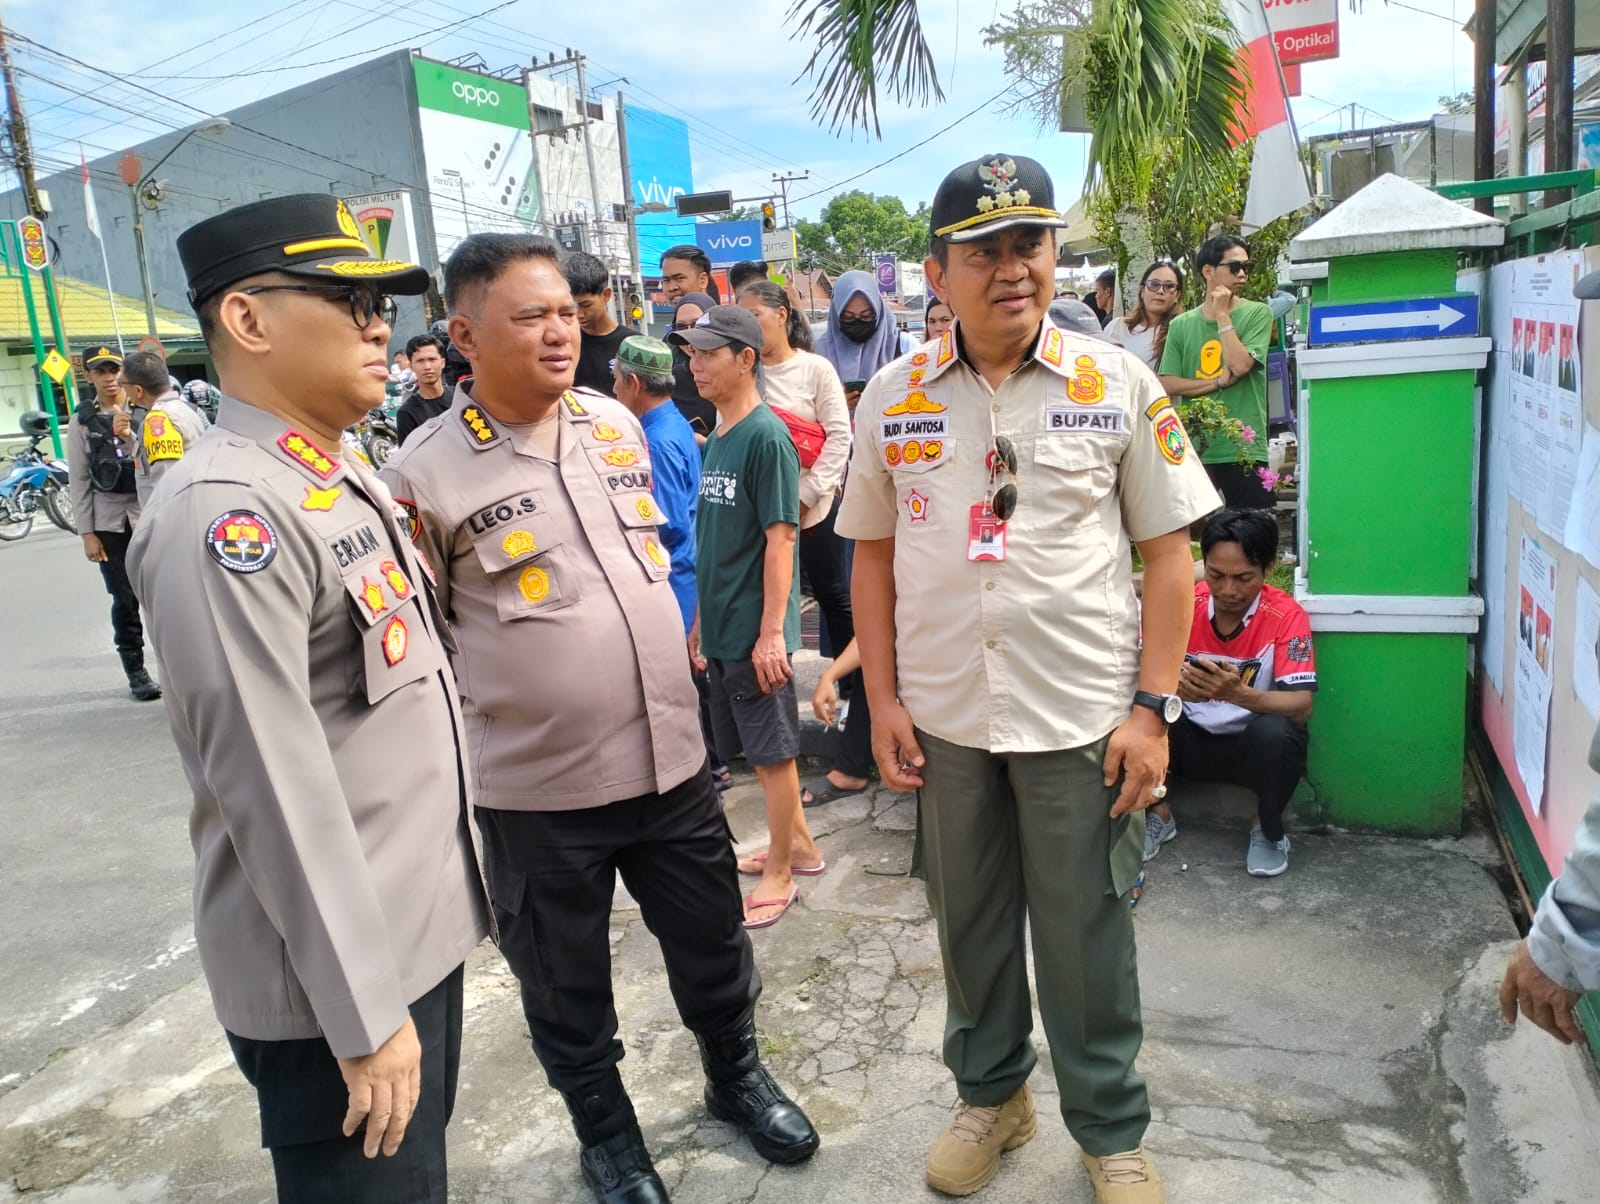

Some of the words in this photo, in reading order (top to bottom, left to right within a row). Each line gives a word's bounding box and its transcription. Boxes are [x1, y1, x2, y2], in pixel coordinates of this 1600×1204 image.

[1283, 29, 1334, 52] Optikal
[452, 81, 499, 107] oppo
[371, 192, 401, 204] MILITER
[707, 234, 752, 250] vivo
[884, 423, 902, 437] BUDI
[904, 421, 944, 434] SANTOSA
[1052, 414, 1117, 430] BUPATI
[468, 497, 536, 534] LEO.S
[330, 525, 380, 568] ERLAN
